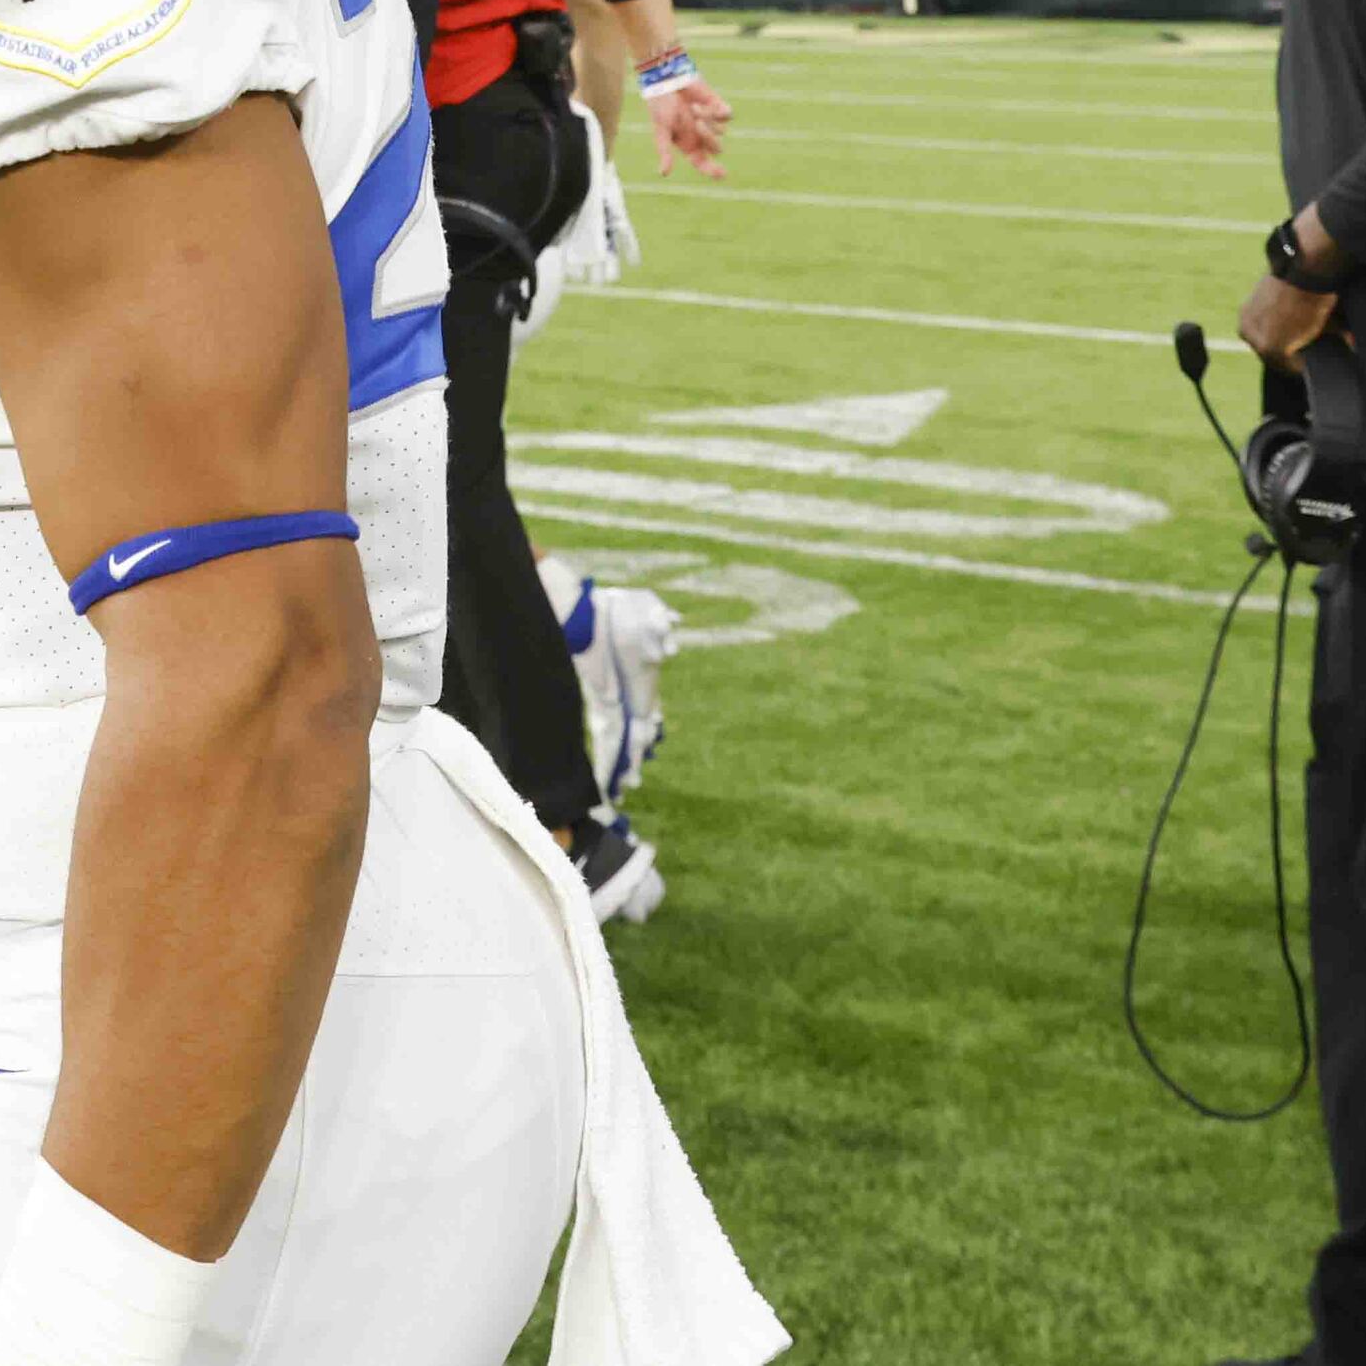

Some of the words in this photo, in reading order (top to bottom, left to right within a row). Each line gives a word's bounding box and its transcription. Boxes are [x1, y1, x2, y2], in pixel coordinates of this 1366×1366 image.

[5, 35, 53, 65] STATES
[53, 54, 79, 75] AIR
[80, 31, 124, 69] FORCE
